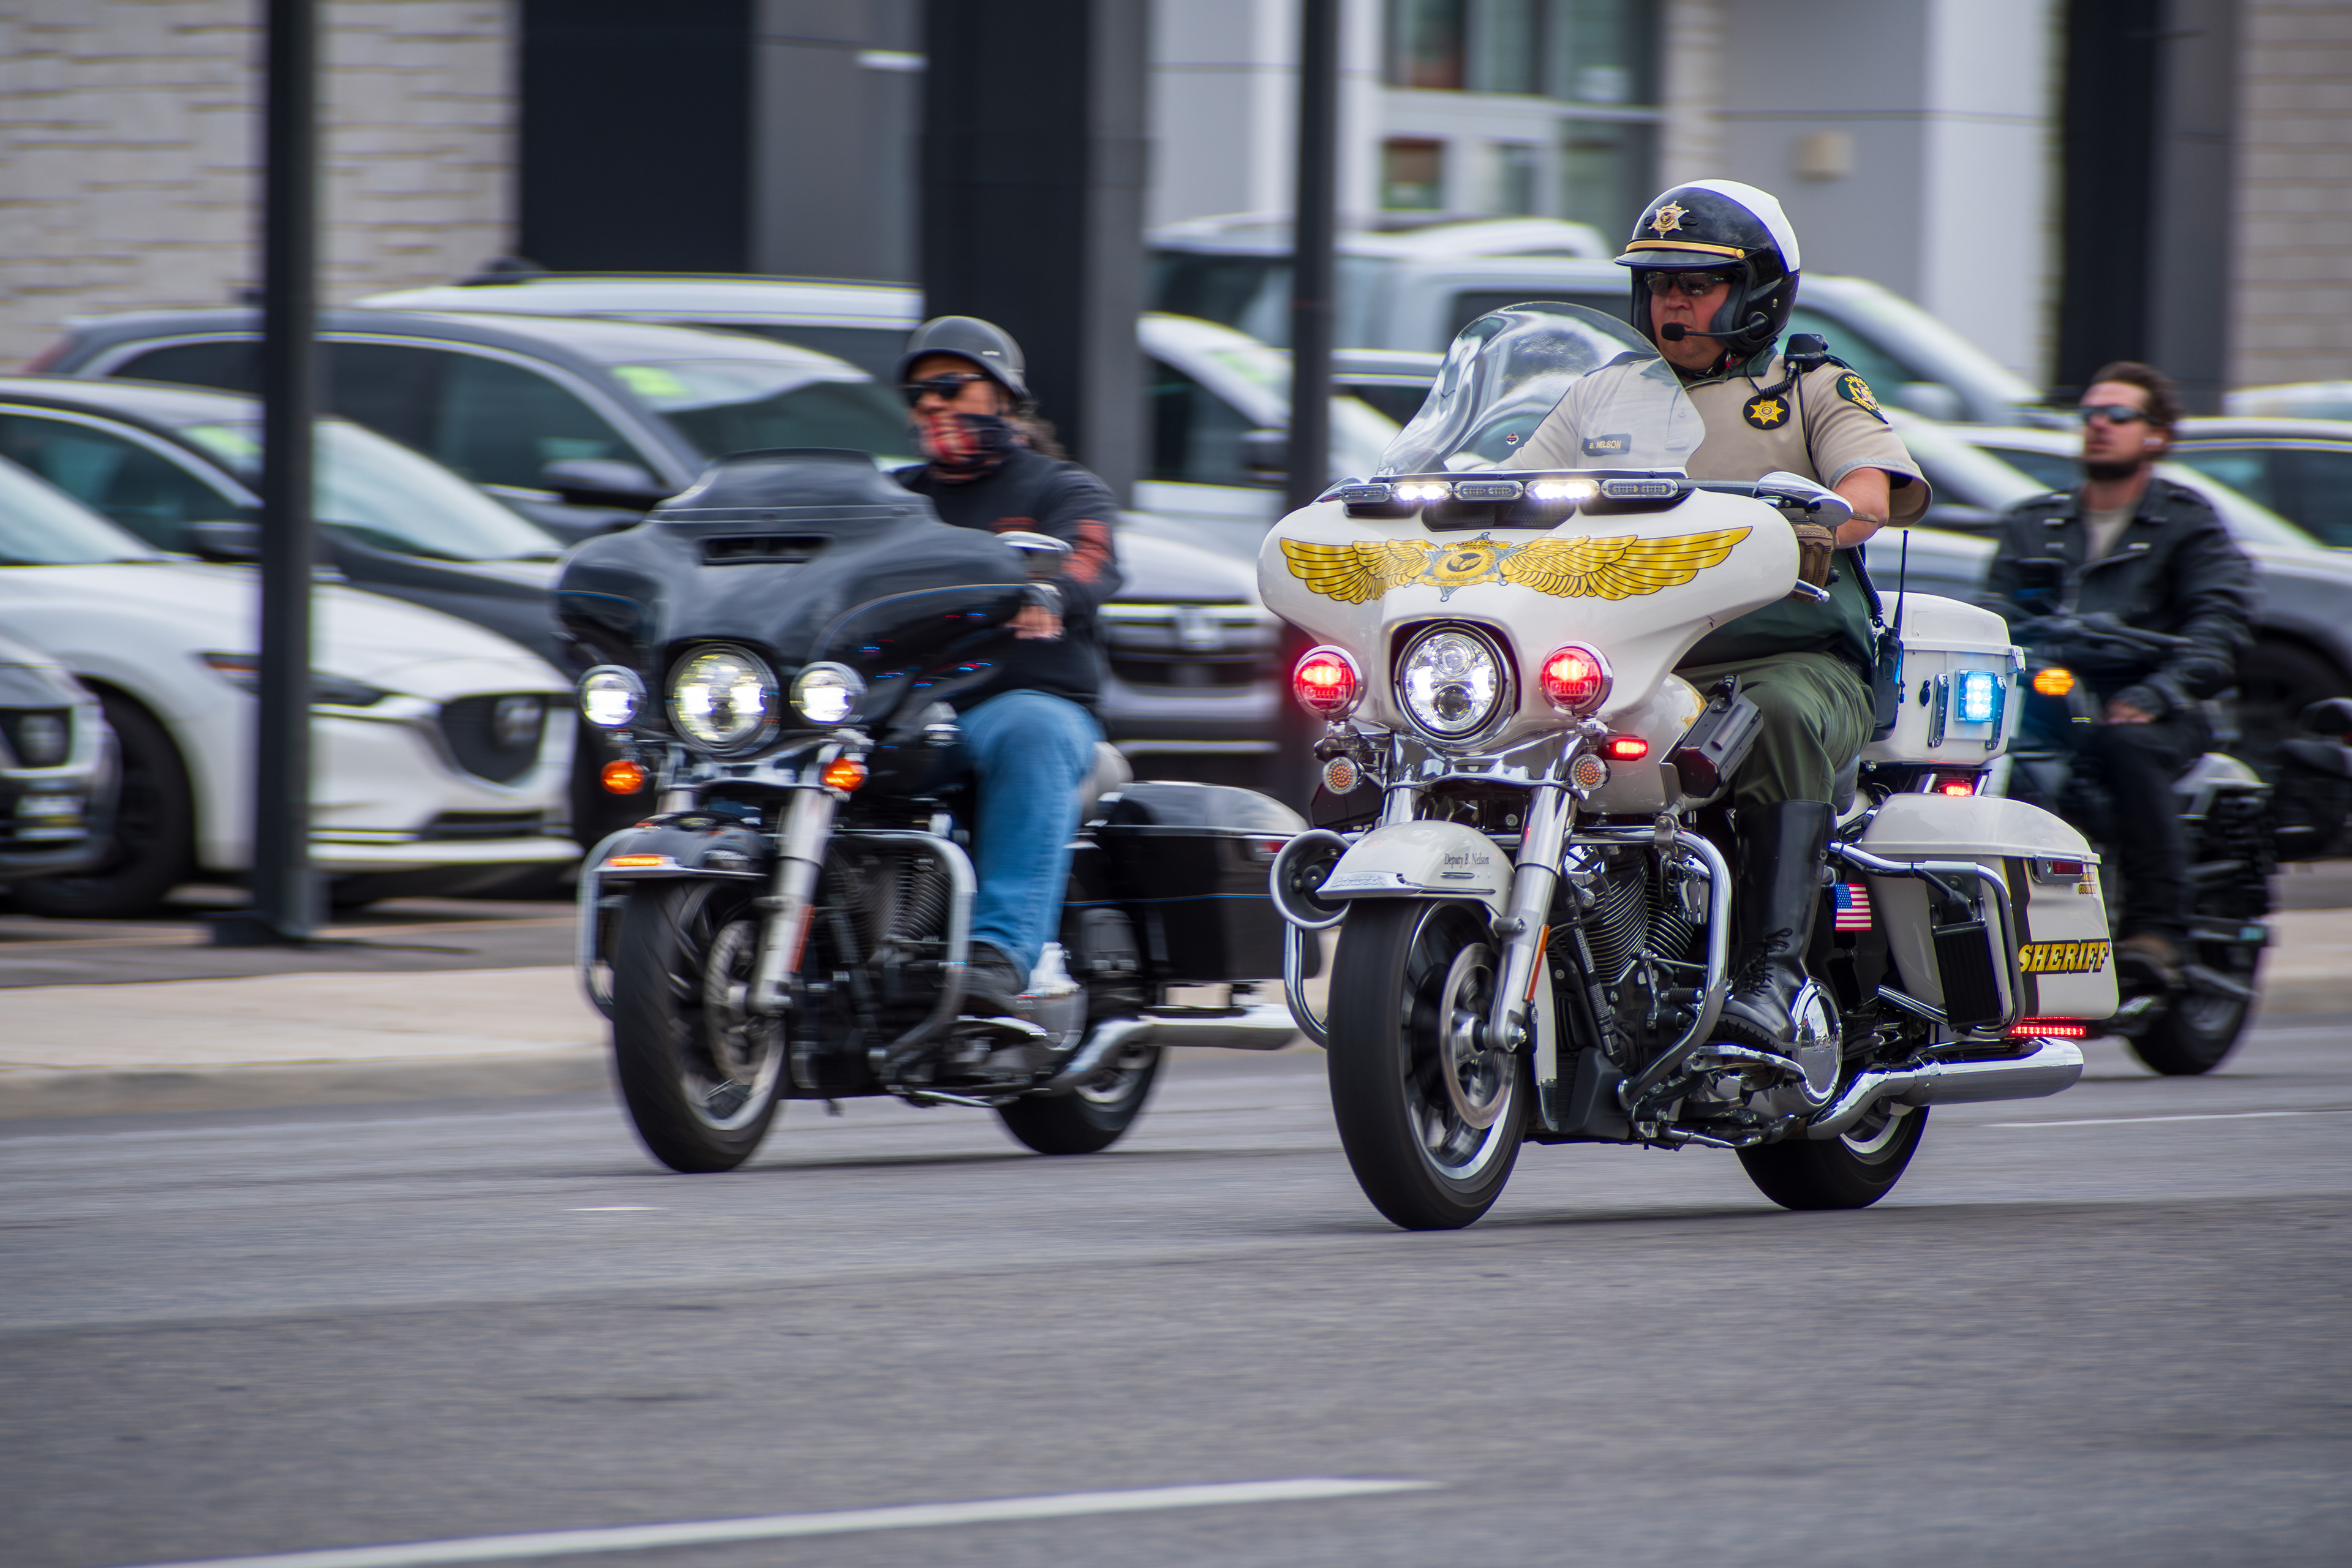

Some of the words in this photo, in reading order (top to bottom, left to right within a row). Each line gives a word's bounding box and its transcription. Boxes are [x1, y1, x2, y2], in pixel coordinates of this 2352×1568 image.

[1596, 440, 1622, 449] NELSON
[1444, 853, 1464, 869] Deputy
[1464, 853, 1471, 865] B.
[1471, 852, 1490, 865] Nelson
[2081, 872, 2095, 882] ACHE
[2078, 884, 2097, 894] COUNTY
[2018, 940, 2111, 973] SHERIFF
